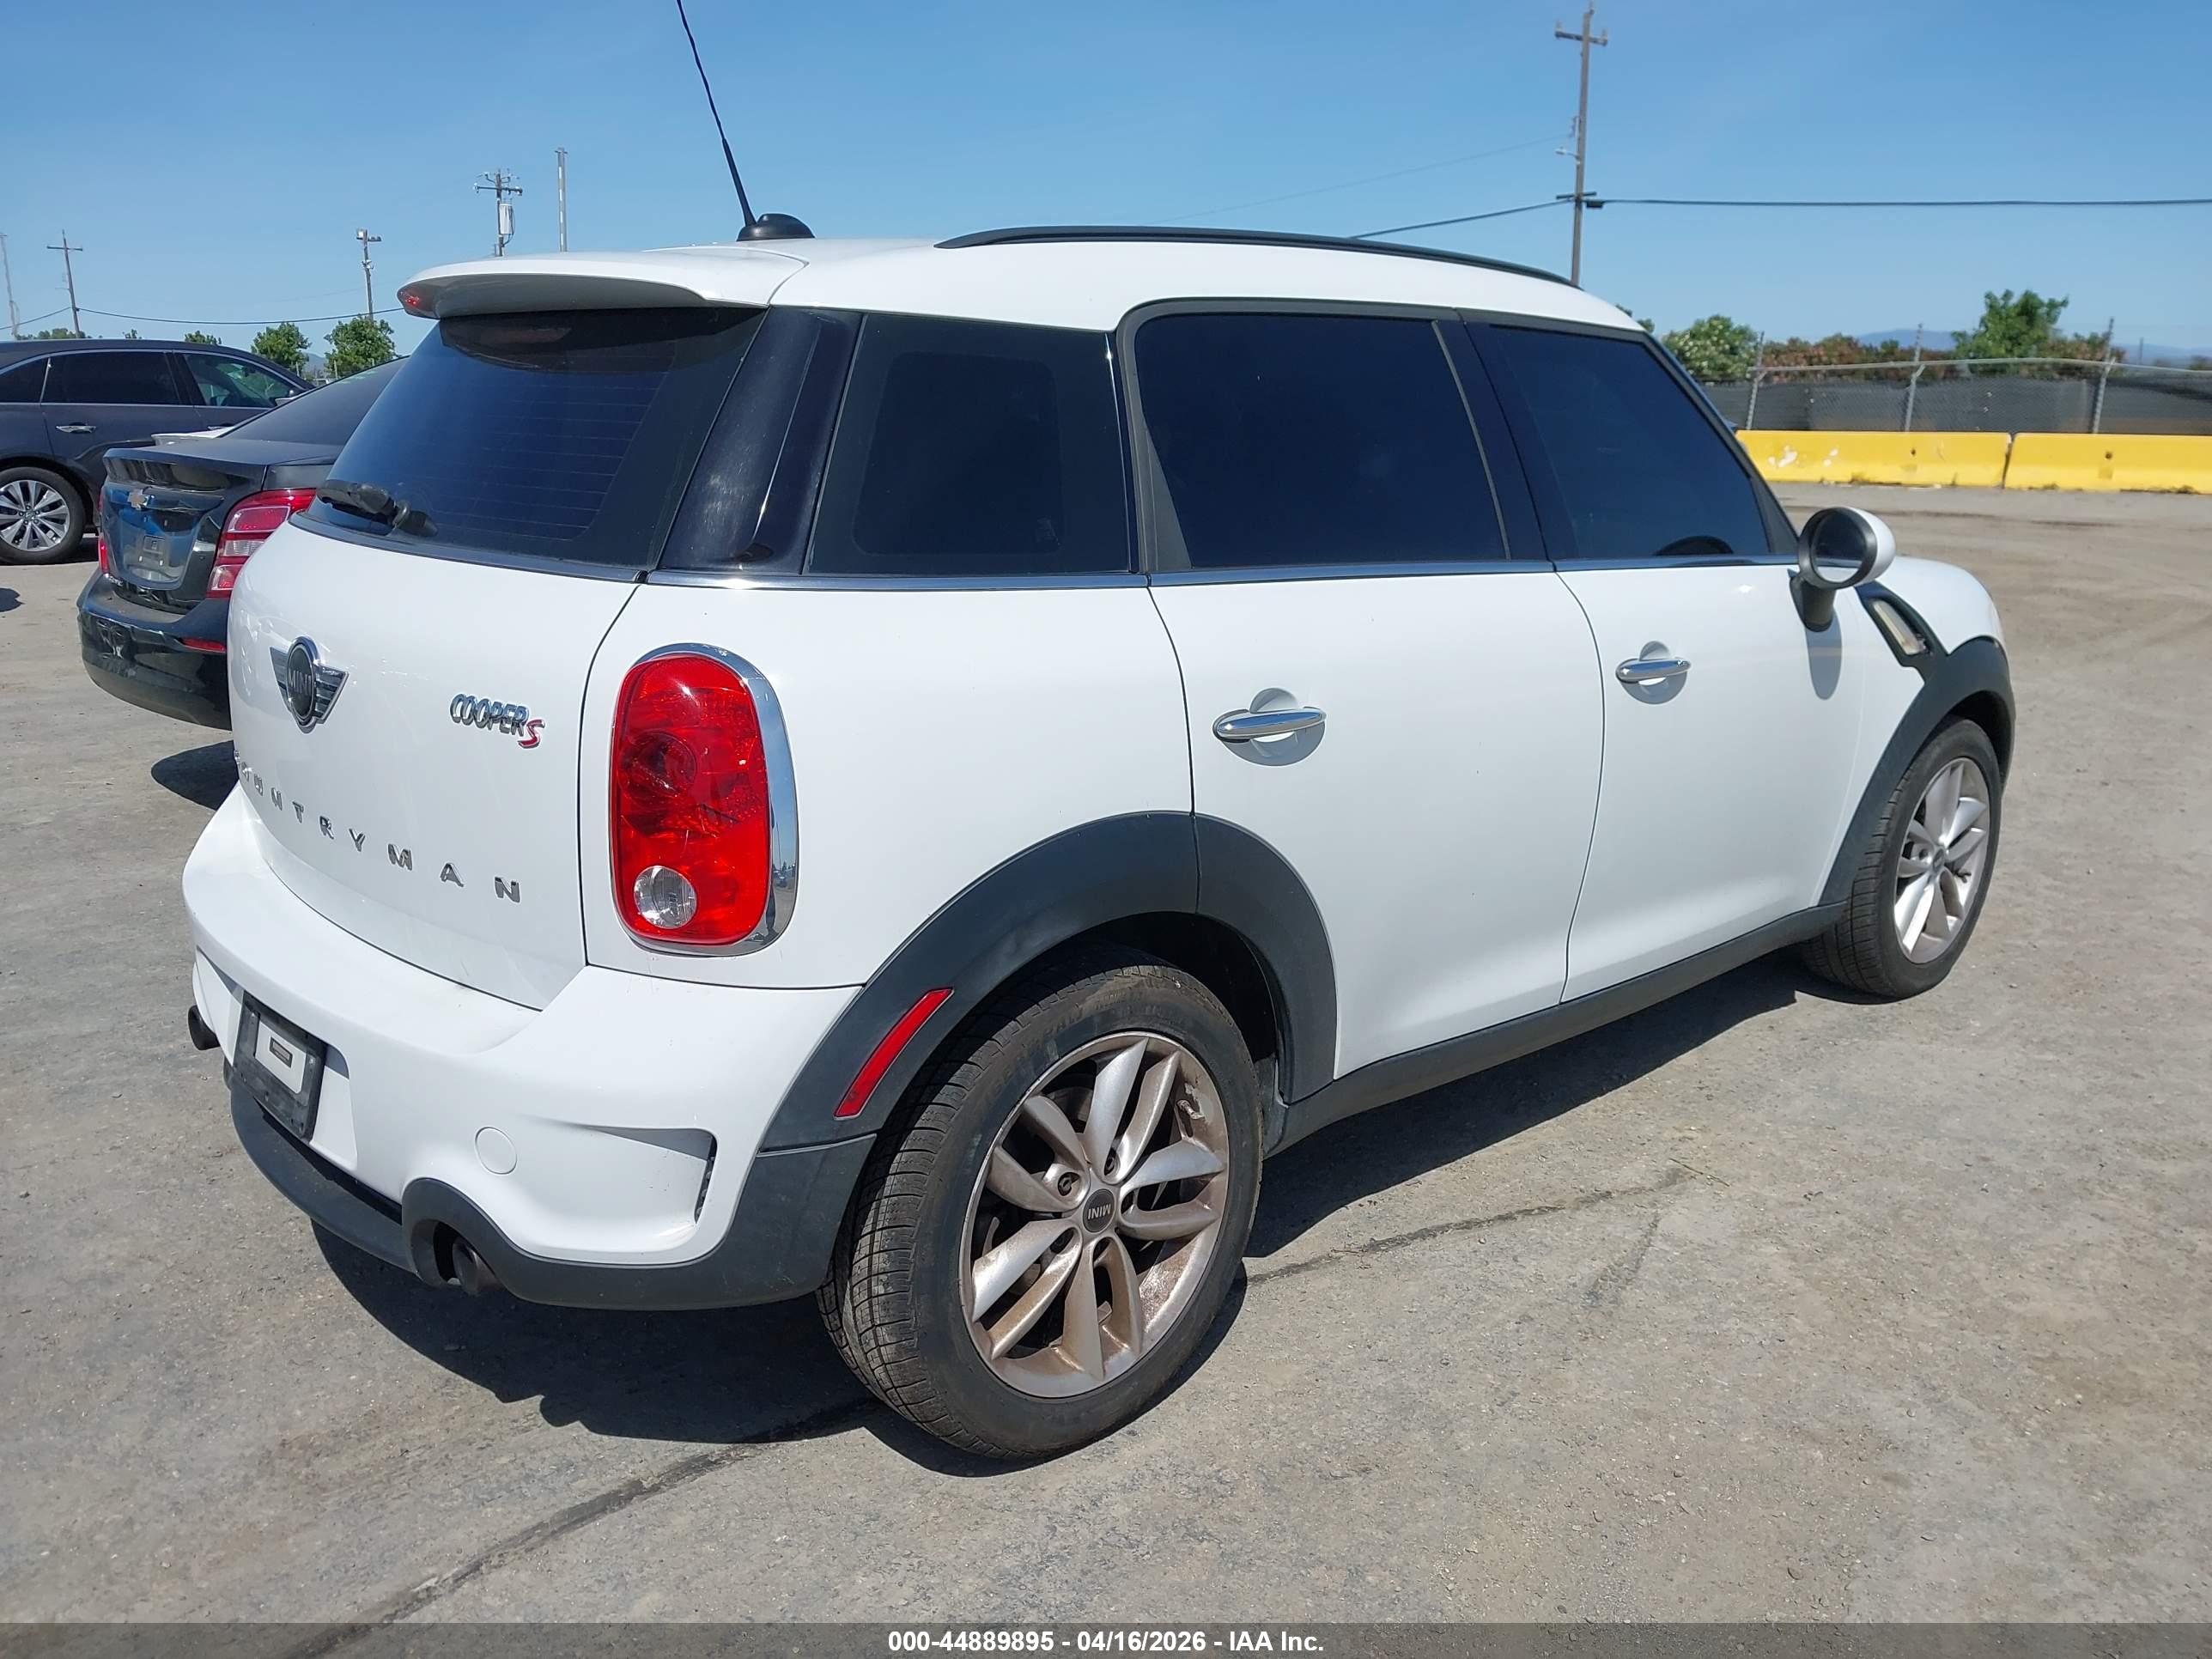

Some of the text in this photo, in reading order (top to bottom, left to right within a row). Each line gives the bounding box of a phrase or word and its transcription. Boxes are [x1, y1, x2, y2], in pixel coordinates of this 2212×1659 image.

[288, 668, 312, 696] MINI
[449, 693, 546, 750] COOPER S
[1087, 1203, 1111, 1220] MINI
